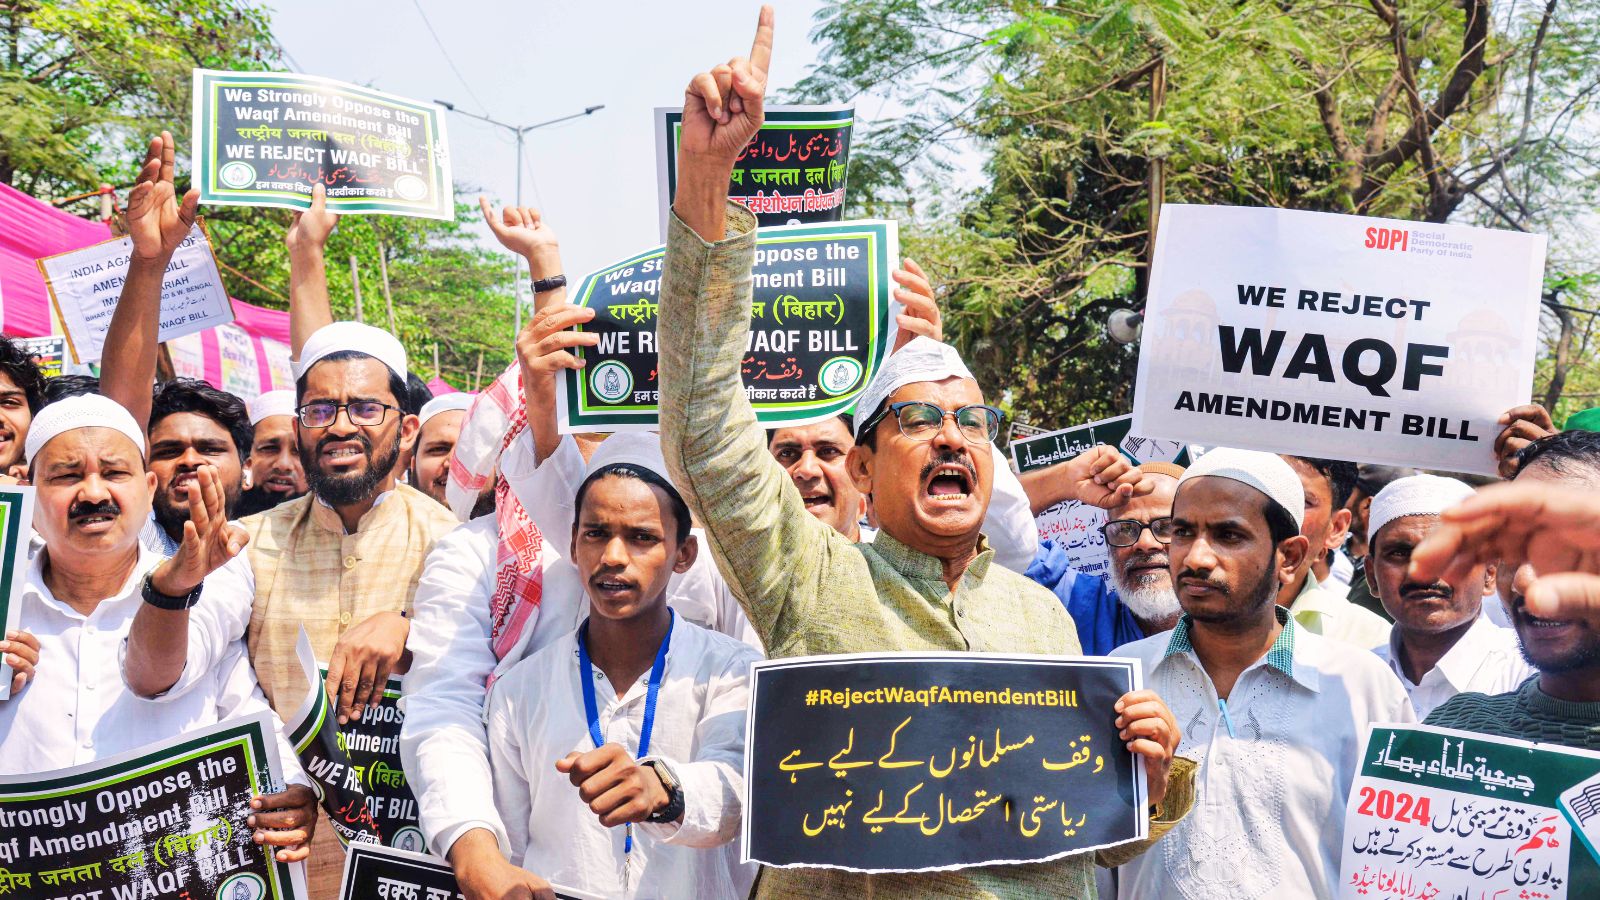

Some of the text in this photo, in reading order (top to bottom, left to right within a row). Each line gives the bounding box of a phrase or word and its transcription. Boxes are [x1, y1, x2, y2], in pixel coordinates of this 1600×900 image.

[224, 88, 419, 126] We Strongly Oppose the
[235, 107, 411, 139] Waqf Amendment Bill
[236, 127, 281, 141] राष्ट्रीय
[287, 129, 329, 142] जनता
[225, 144, 422, 175] WE REJECT WAQF BILL
[750, 169, 801, 186] जनता
[805, 168, 825, 185] दल
[748, 189, 804, 214] संशोधन
[1365, 227, 1408, 251] SDPI
[1411, 238, 1473, 251] Democratic
[1412, 230, 1446, 240] Social
[605, 243, 860, 283] We ppose the
[1411, 246, 1434, 256] Party
[1449, 251, 1472, 259] India
[70, 264, 104, 279] INDIA
[187, 281, 213, 293] BENGAL
[811, 268, 847, 287] Bill
[773, 293, 845, 326] (बिहार)
[1237, 284, 1431, 320] WE REJECT
[159, 310, 208, 329] WAQF BILL
[597, 332, 631, 355] WE
[808, 329, 859, 352] BILL
[1218, 325, 1450, 397] WAQF
[634, 390, 651, 403] हम
[779, 386, 807, 400] करते
[1174, 390, 1479, 442] AMENDMENT BILL
[805, 685, 1079, 710] #RejectWaqfAmendentBill
[362, 703, 405, 726] ppos
[778, 716, 1105, 784] وقف مسلمانوں کے لیے ہے
[308, 756, 344, 786] WE
[0, 756, 237, 828] trongly Oppose the
[1358, 786, 1431, 826] 2024
[388, 797, 418, 820] BIL
[802, 789, 853, 838] نہیں
[920, 789, 1010, 836] استحصال
[1020, 794, 1086, 838] ریاستی
[1432, 798, 1460, 833] بل
[0, 786, 229, 864] qf Amendment Bill
[1352, 827, 1380, 856] ہیں
[40, 861, 102, 889] जनता
[109, 850, 145, 873] दल
[111, 846, 254, 900] WAQF BILL
[1448, 854, 1471, 870] سے
[1472, 847, 1514, 879] طرح
[1513, 858, 1563, 890] پوری
